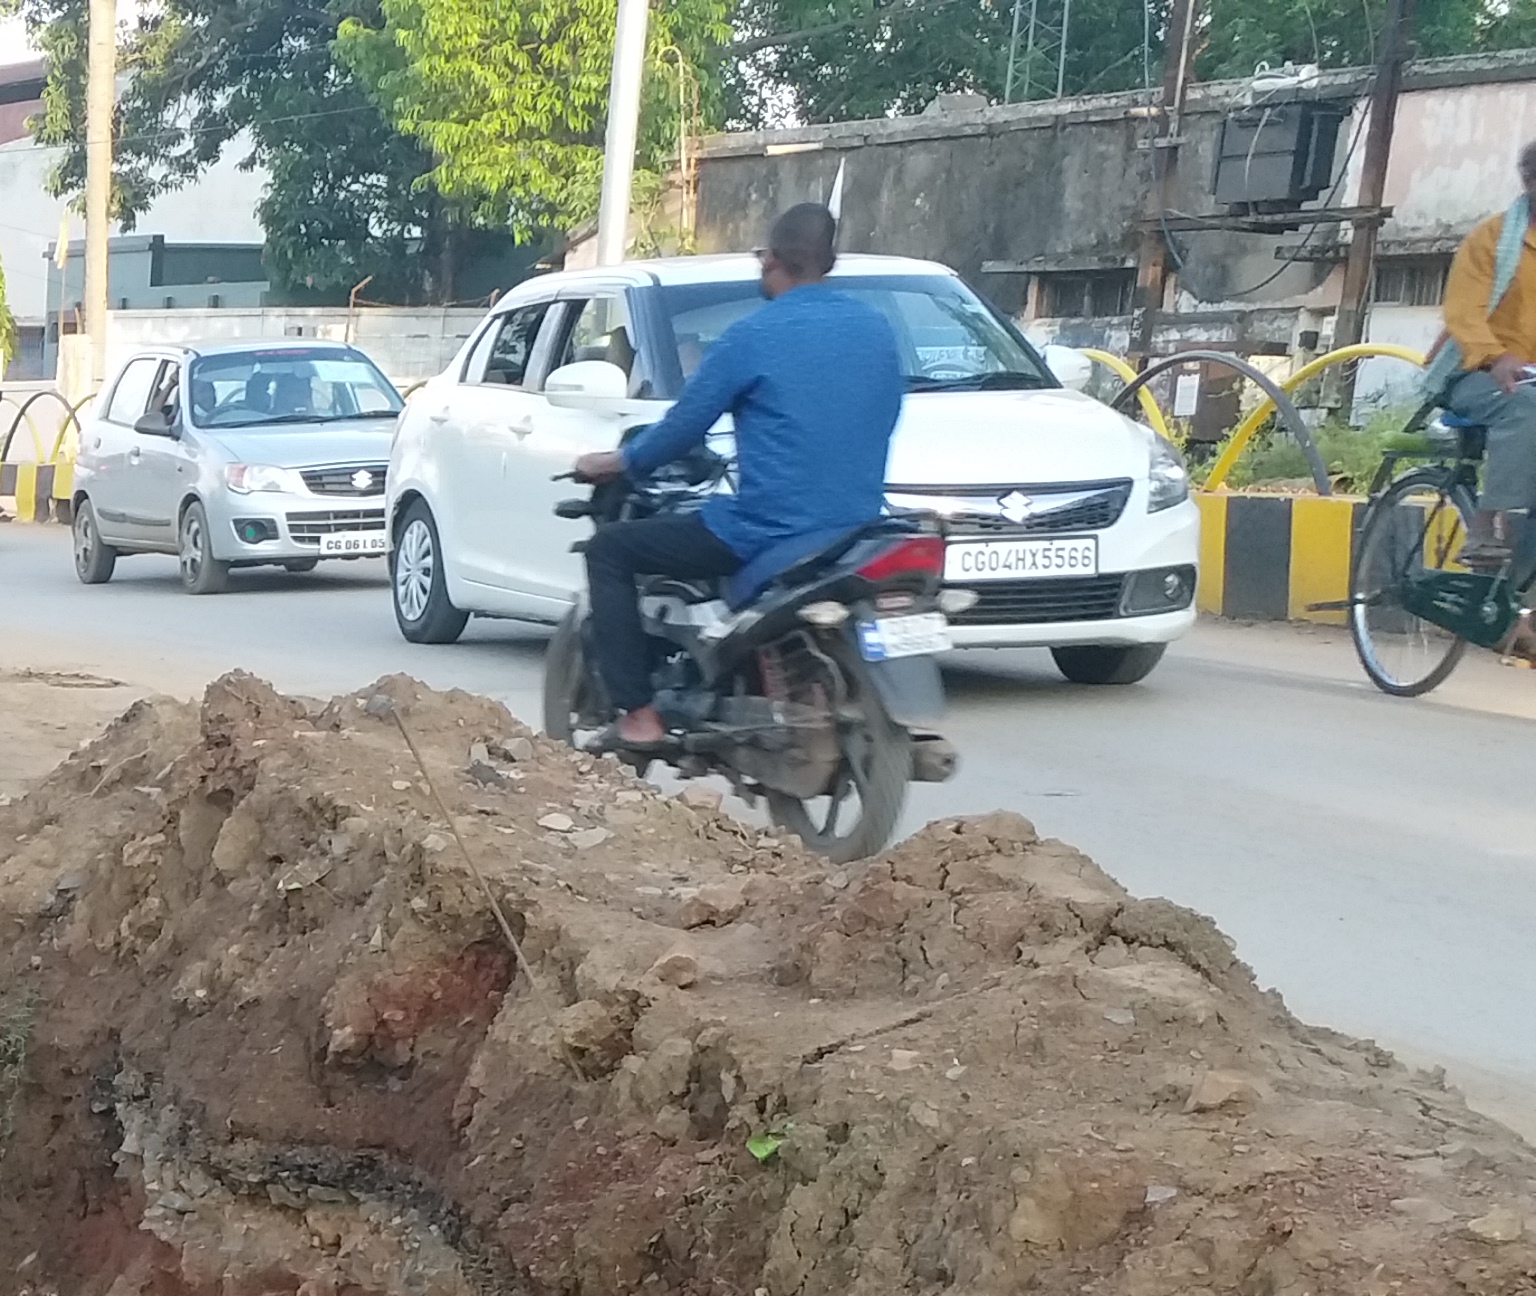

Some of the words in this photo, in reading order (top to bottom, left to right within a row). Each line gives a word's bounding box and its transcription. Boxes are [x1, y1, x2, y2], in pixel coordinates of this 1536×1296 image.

[326, 540, 342, 550] CG
[345, 539, 360, 550] 06
[961, 546, 1093, 572] CG04HX5566
